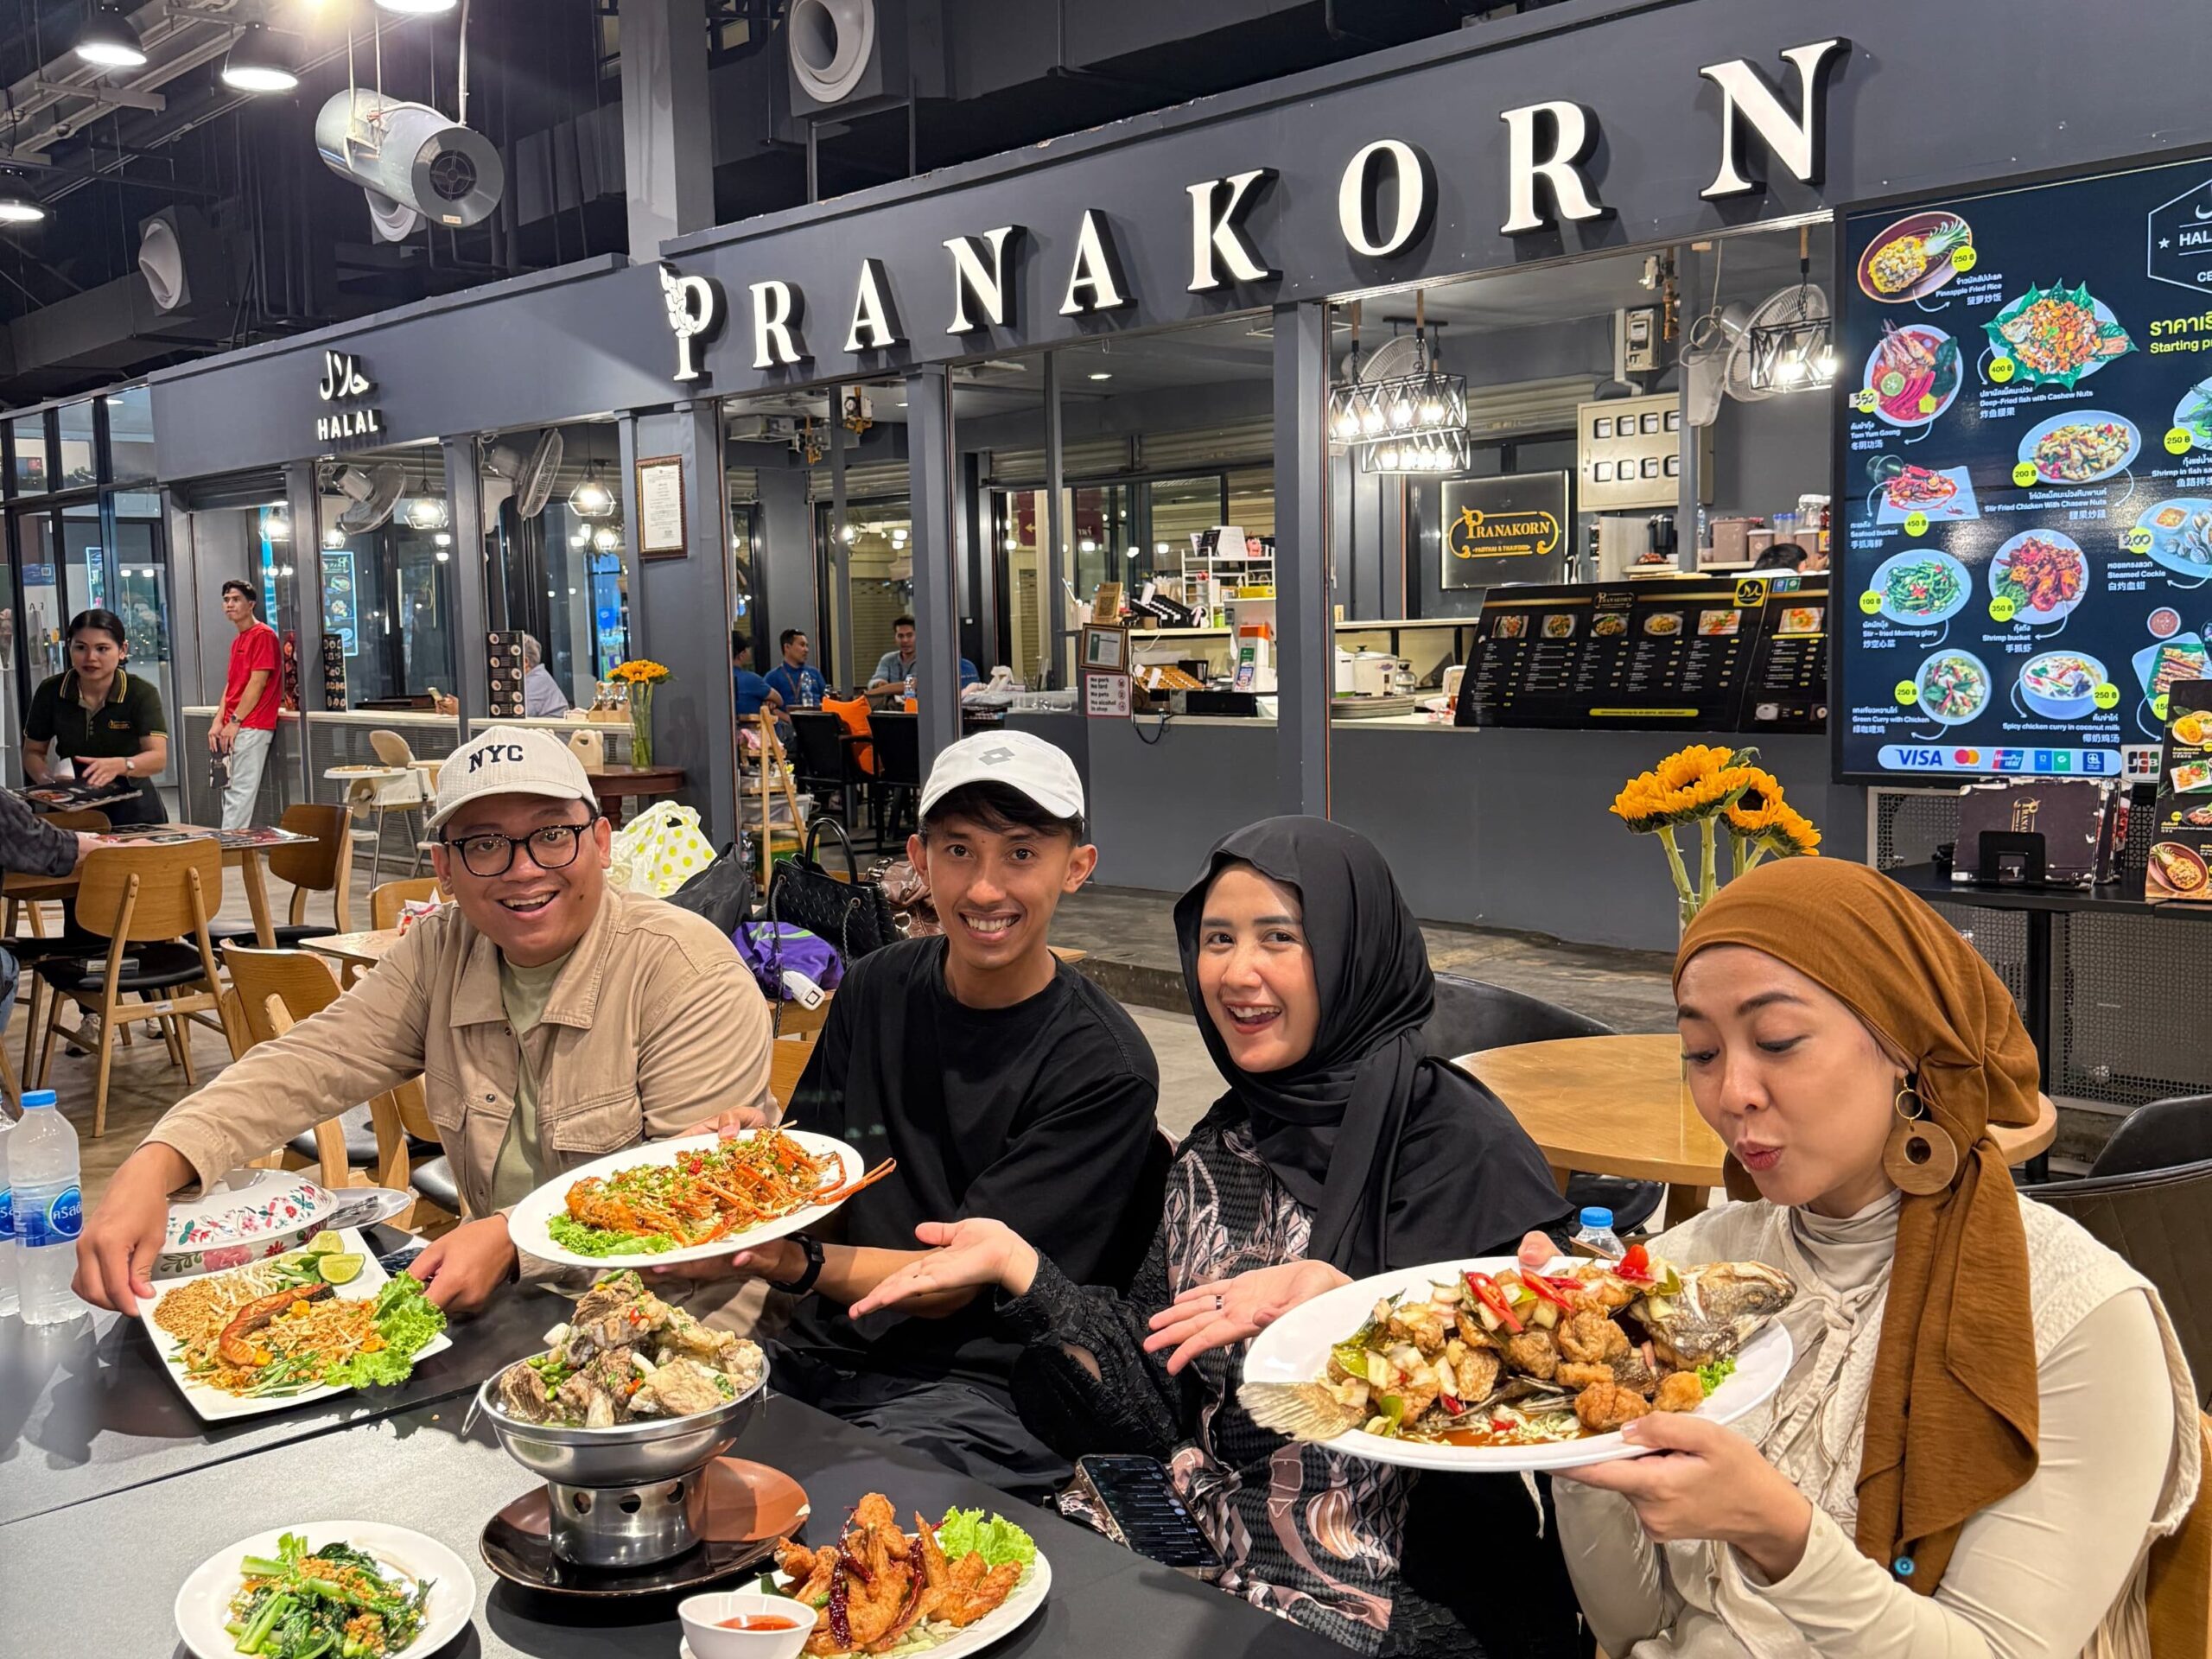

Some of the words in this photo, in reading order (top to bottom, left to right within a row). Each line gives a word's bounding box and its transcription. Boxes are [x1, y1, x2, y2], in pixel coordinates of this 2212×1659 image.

[658, 36, 1846, 382] PRANAKORN
[1936, 287, 1968, 297] Pineapple
[1969, 284, 1986, 293] Fried
[1987, 283, 2002, 291] Rice
[2150, 340, 2199, 354] Starting
[320, 351, 370, 401] حلال
[1853, 392, 1874, 406] 350
[2048, 392, 2075, 401] Cashew
[317, 409, 378, 442] HALAL
[2152, 469, 2179, 478] Shrimp
[2016, 502, 2044, 511] Chicken
[1462, 505, 1551, 539] PRANAKORN
[2123, 534, 2152, 546] 200
[1982, 634, 2007, 643] Shrimp
[468, 745, 524, 773] NYC
[1895, 748, 1943, 766] VISA
